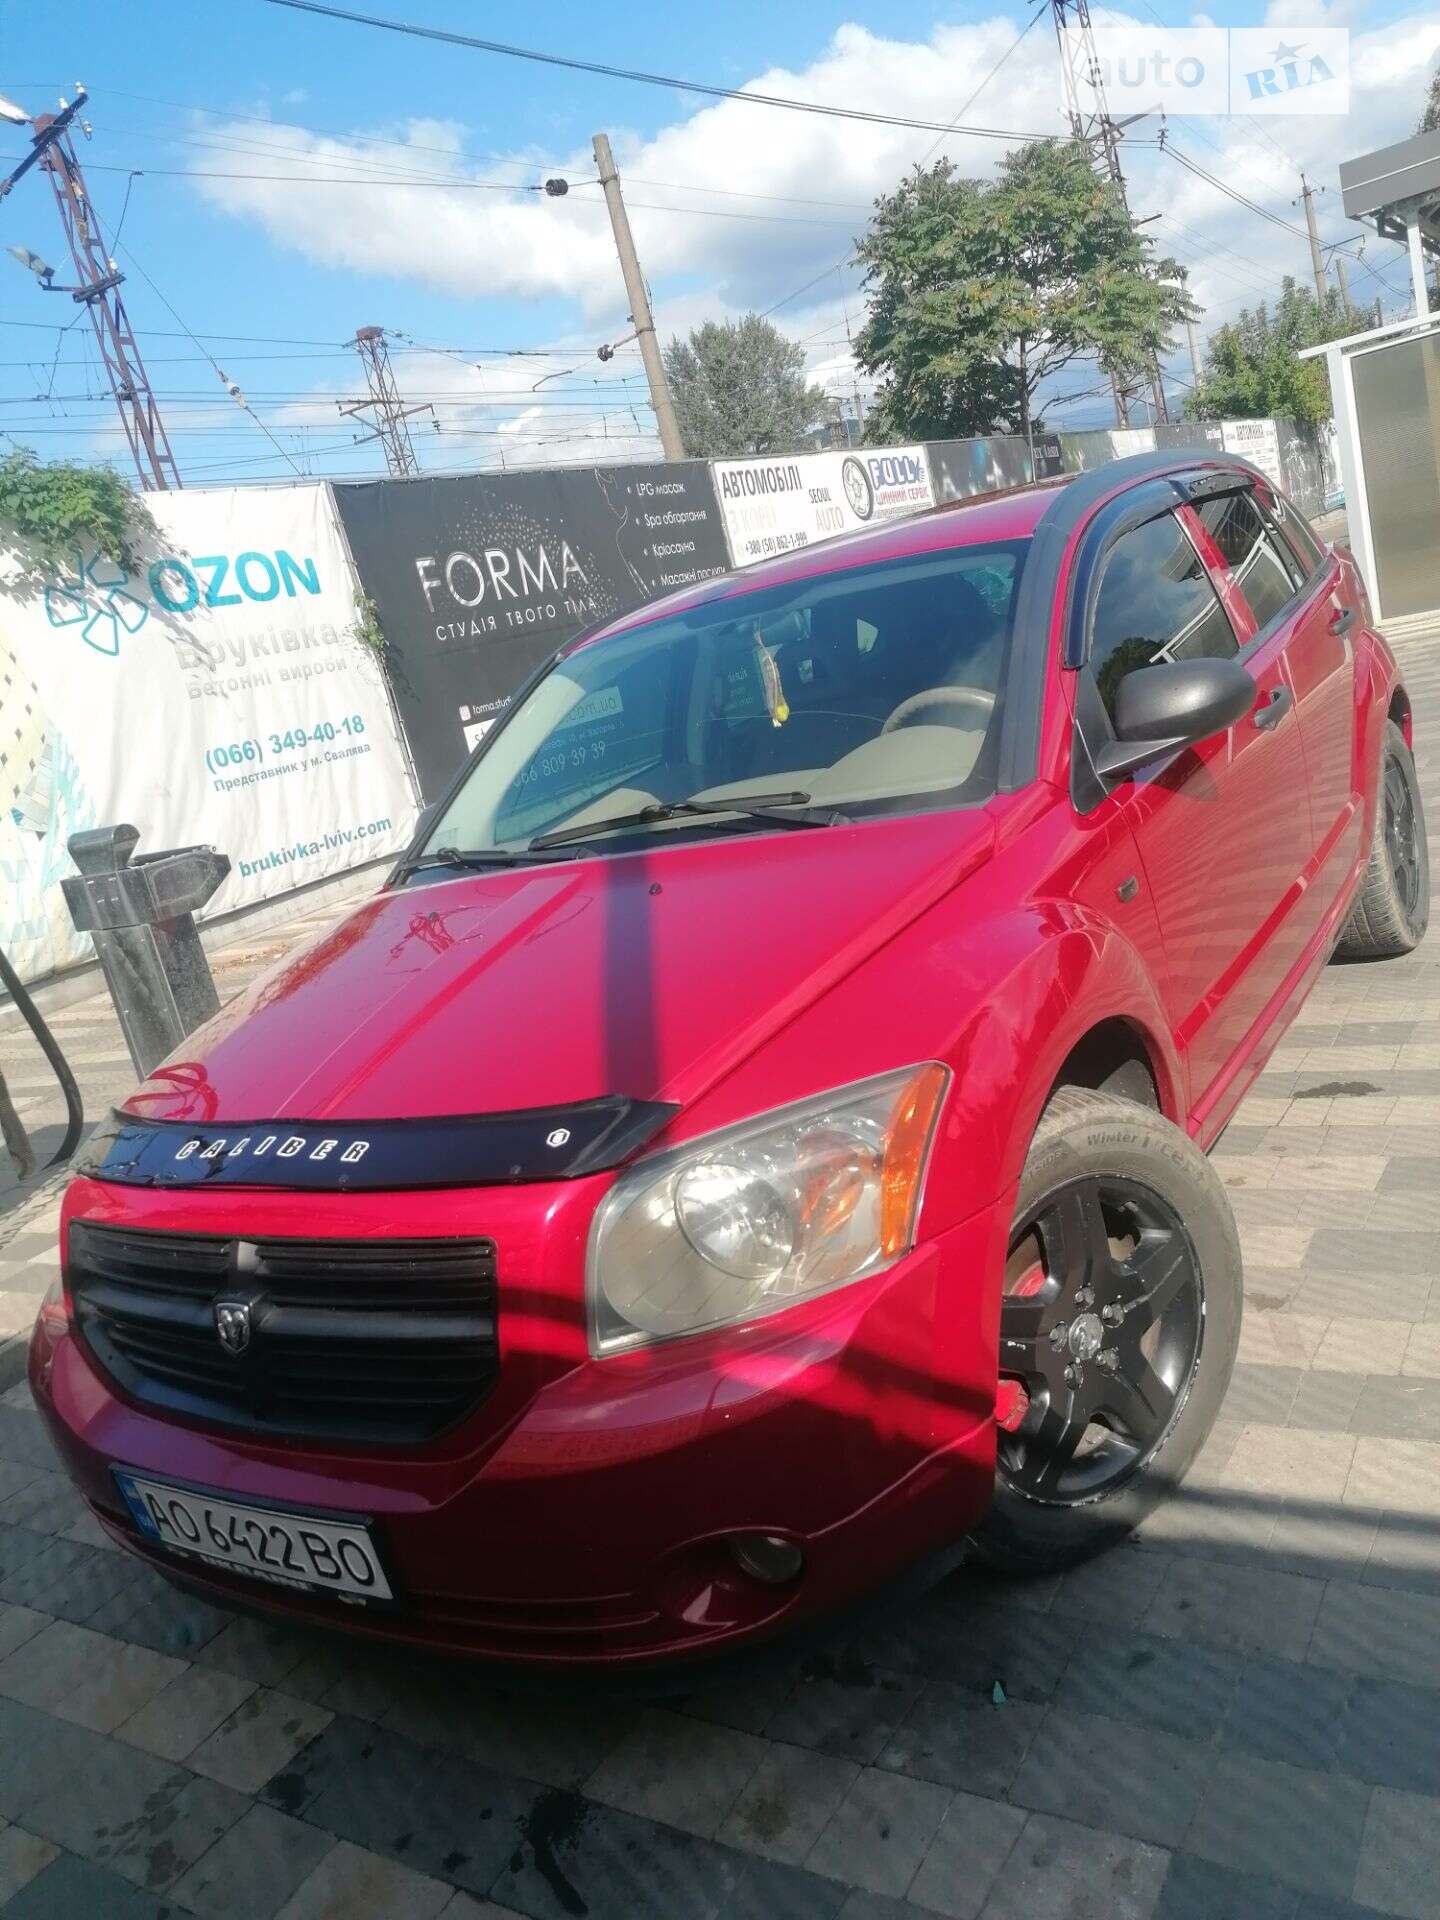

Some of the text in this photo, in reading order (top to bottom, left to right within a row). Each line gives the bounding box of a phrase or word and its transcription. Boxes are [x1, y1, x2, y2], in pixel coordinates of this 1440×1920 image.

[636, 483, 655, 496] LPG
[721, 464, 803, 499] АВТОМОБІЛІ
[644, 513, 662, 528] Spa
[815, 505, 845, 532] AUTO
[148, 550, 321, 613] OZON
[415, 540, 590, 614] FORMA
[435, 596, 597, 641] СТУДІЯ ТВОГО ТІЛА
[175, 624, 340, 671] Бруківка
[280, 658, 348, 682] вироби
[205, 714, 366, 775] (066) 349-40-18
[213, 763, 299, 792] Представник
[324, 743, 371, 763] Свалява
[238, 817, 392, 878] brukivka-lviv.com
[174, 1135, 371, 1163] CALIBER
